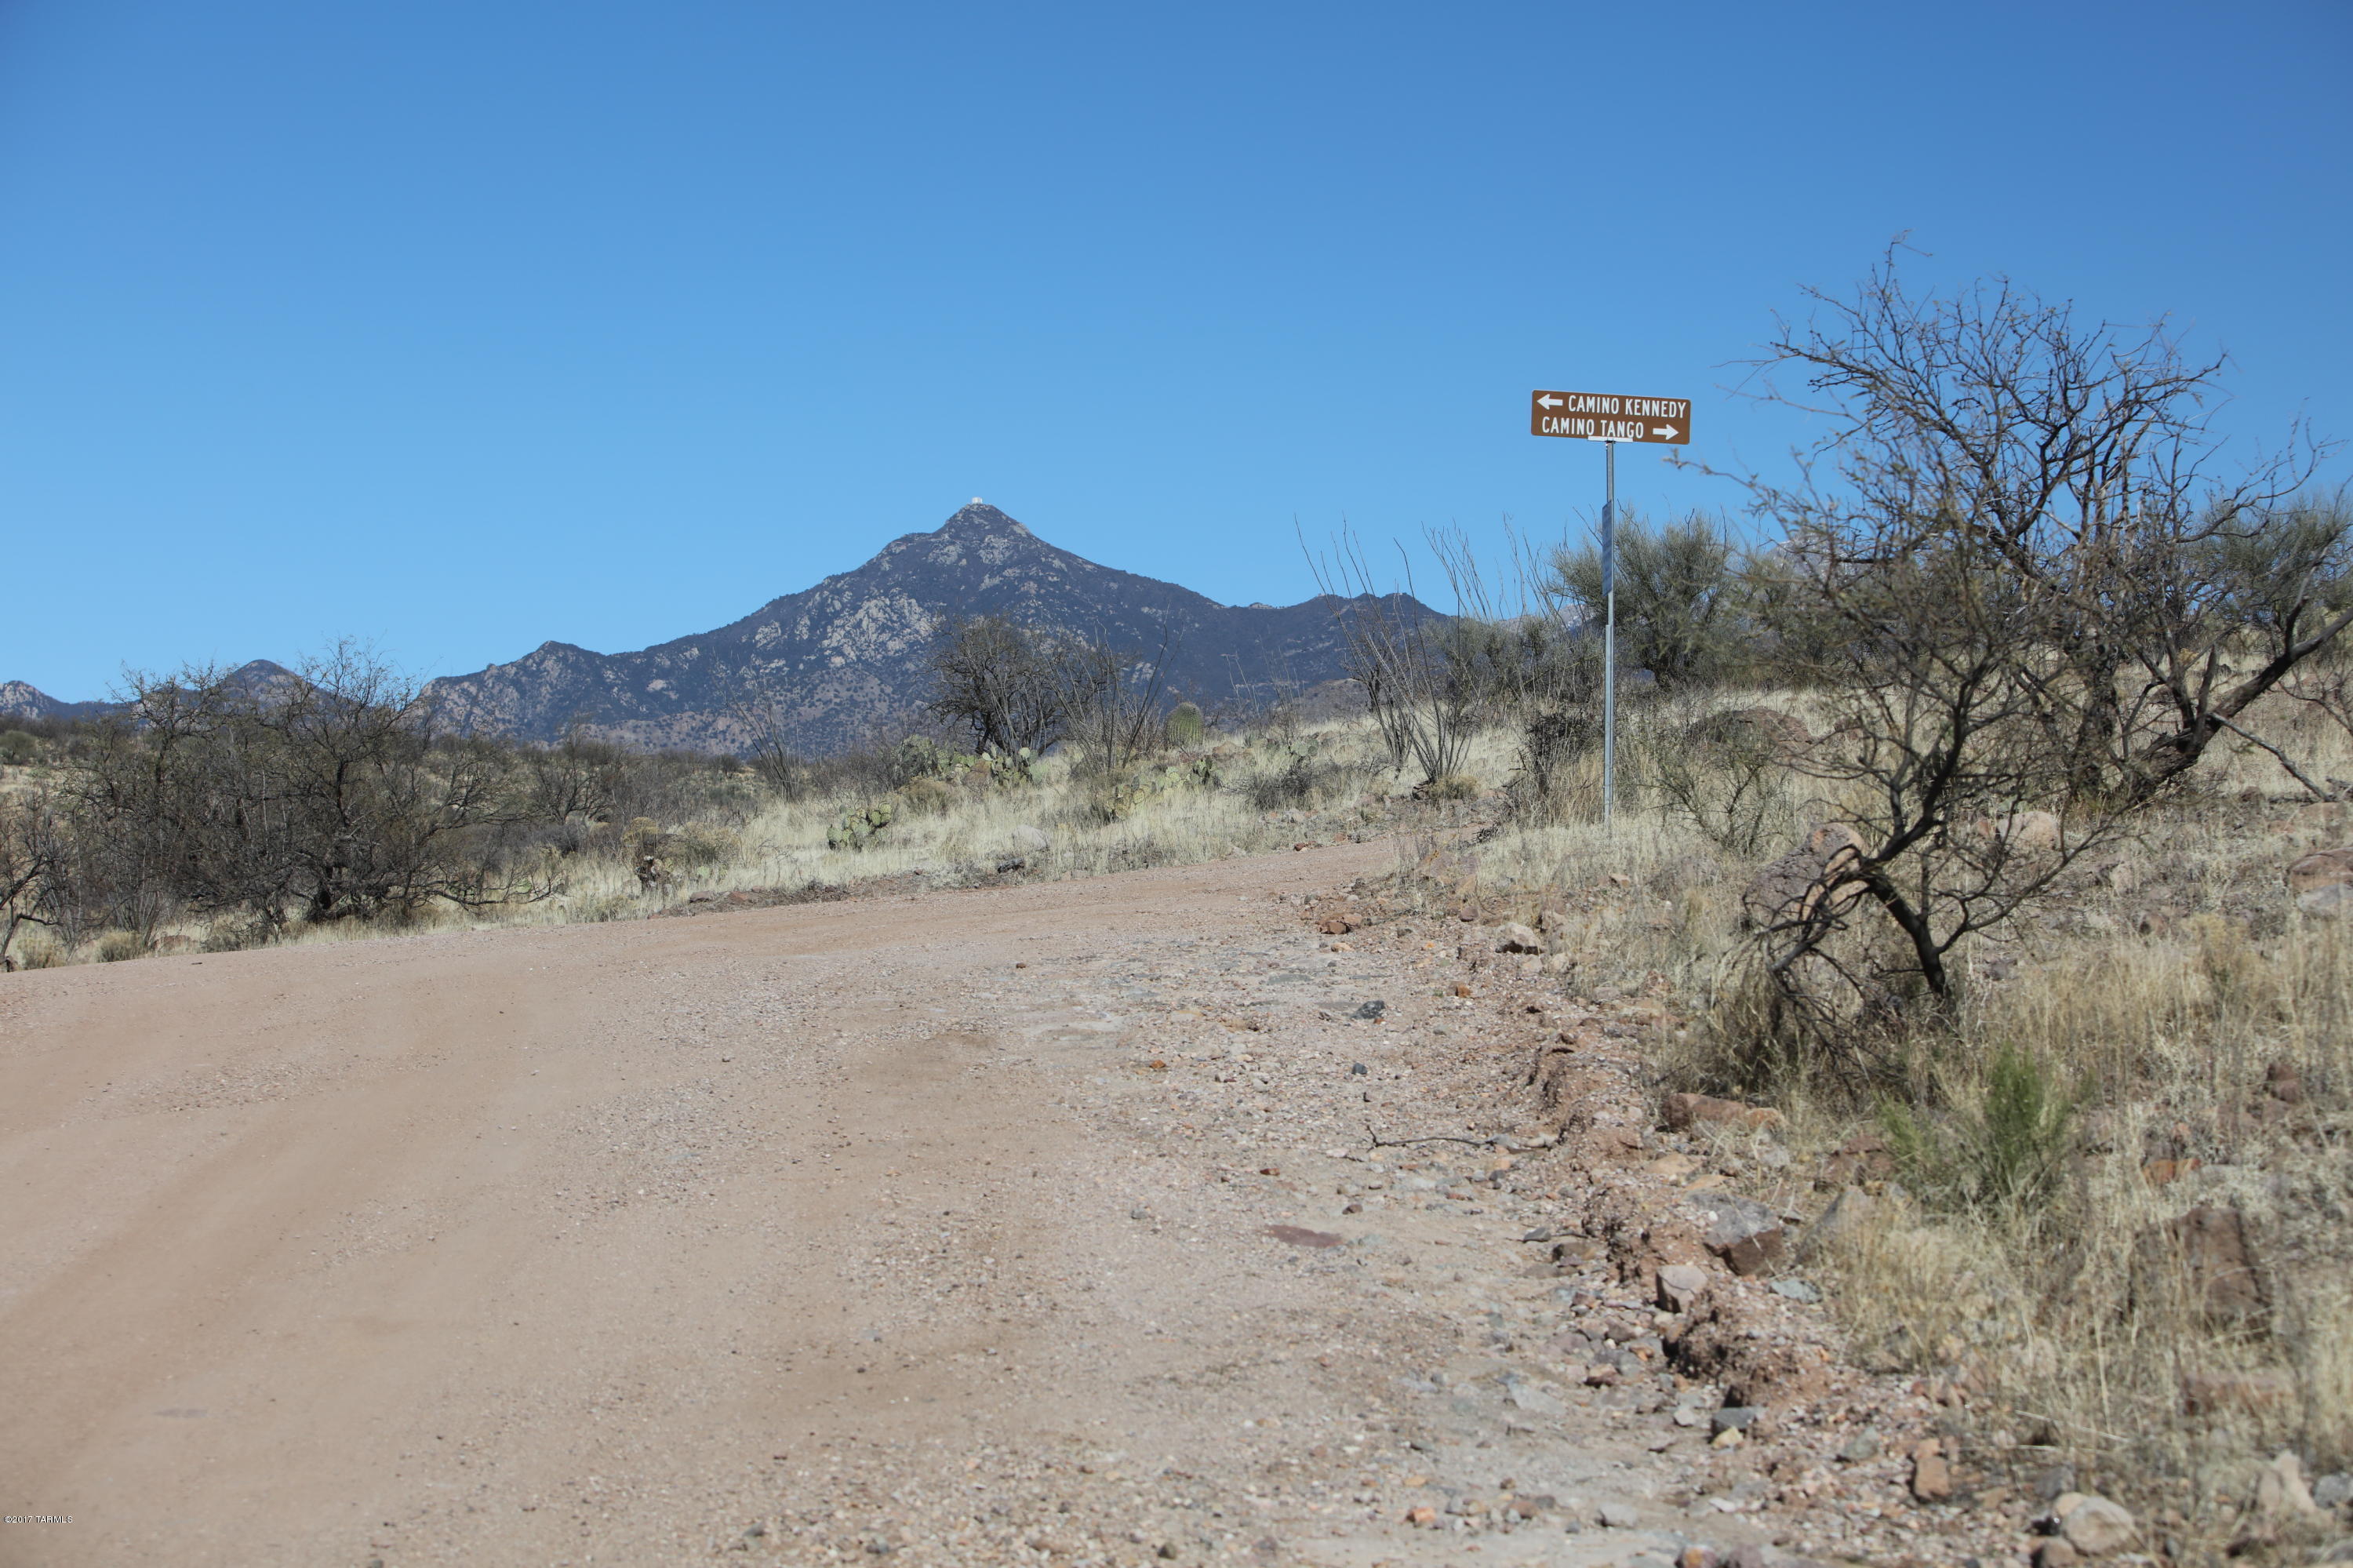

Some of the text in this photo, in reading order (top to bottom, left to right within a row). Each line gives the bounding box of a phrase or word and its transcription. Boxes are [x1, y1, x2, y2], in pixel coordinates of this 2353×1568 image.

[1569, 395, 1686, 418] CAMINO KENNEDY
[1542, 417, 1644, 438] CAMINO TANGO
